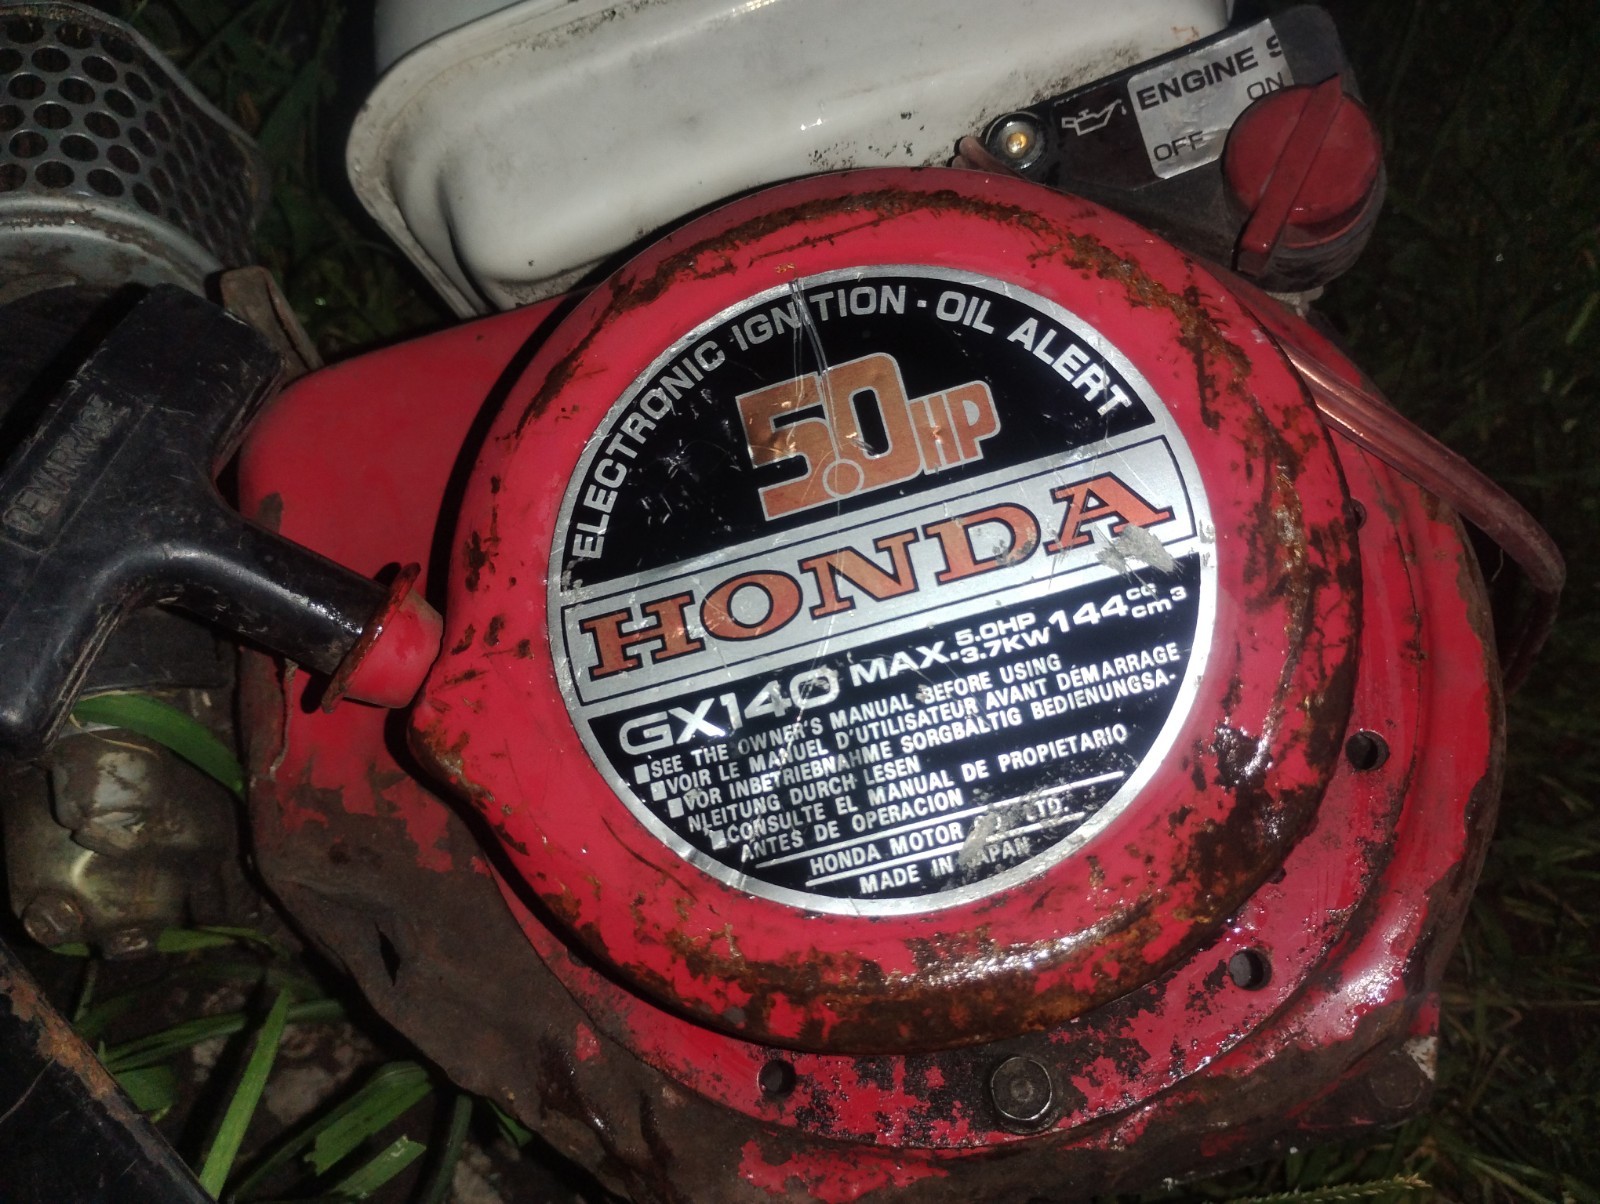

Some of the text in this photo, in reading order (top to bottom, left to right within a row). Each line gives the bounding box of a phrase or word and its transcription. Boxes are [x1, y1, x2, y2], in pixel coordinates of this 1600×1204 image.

[1136, 47, 1259, 112] ENGINE
[1247, 72, 1285, 101] ON
[1153, 130, 1205, 163] OFF
[571, 340, 726, 560] ELECTRONIC
[935, 290, 995, 335] OIL
[1006, 317, 1133, 416] ALERT
[579, 471, 1177, 678] HONDA
[955, 612, 1037, 647] 5.0HP
[961, 626, 1051, 665] 3.7KW
[1048, 594, 1130, 634] 144
[619, 667, 840, 756] GX140
[651, 654, 1063, 779] SEE THE OWNER'S MANUAL BEFORE USING
[666, 768, 712, 795] VOIR
[719, 763, 741, 783] LE
[749, 738, 829, 774] MANUEL
[835, 697, 980, 750] D'UTILISATEUR
[986, 674, 1048, 711] AVANT
[683, 788, 722, 812] VOR
[729, 741, 894, 800] INBETRIEBNAHME
[1031, 670, 1176, 721] BEDIENUNGSA-
[688, 755, 921, 833] NLEITUNG DURCH LESEN
[726, 724, 1129, 844] CONSULTE EL MANUAL DE PROPIETARIO
[741, 829, 804, 860] ANTES
[813, 824, 840, 842] DE
[851, 788, 964, 833] OPERACION
[809, 843, 882, 877] HONDA
[889, 821, 965, 855] MOTOR
[858, 836, 1031, 895] MADE IN APAN
